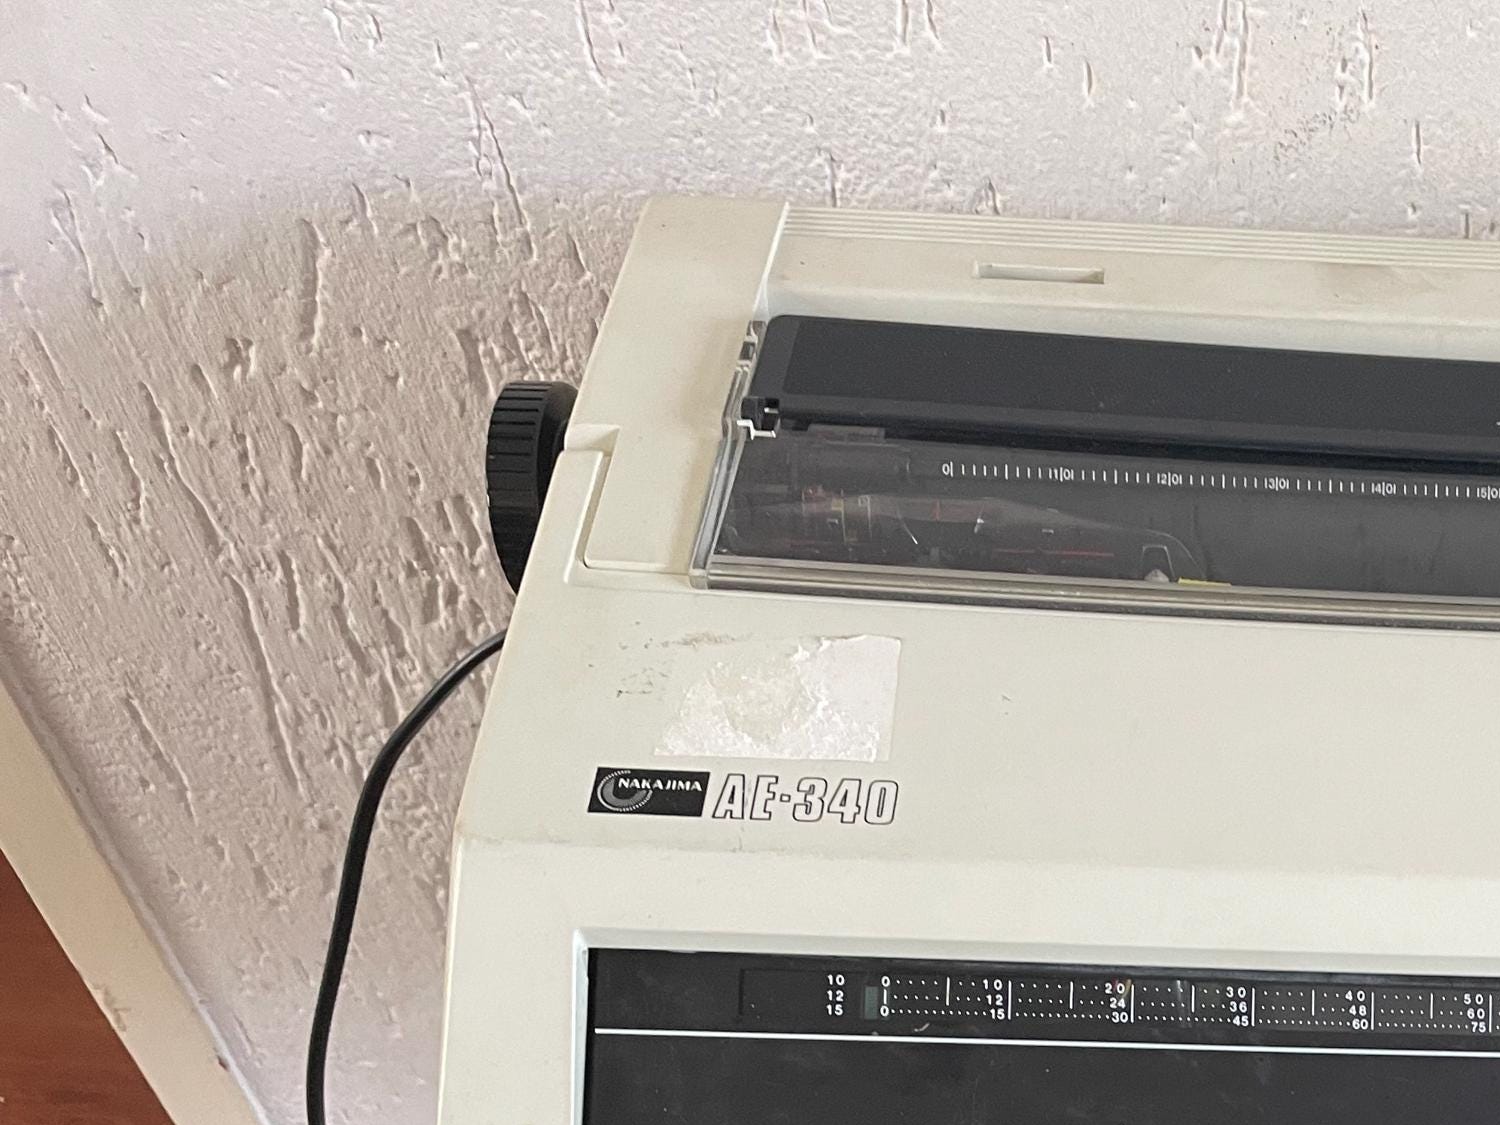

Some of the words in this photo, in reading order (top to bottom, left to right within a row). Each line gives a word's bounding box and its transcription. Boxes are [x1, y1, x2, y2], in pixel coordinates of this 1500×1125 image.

[617, 777, 702, 791] NAKAJIMA
[712, 773, 898, 825] AE-340
[827, 974, 845, 986] 10
[881, 976, 890, 987] 0
[983, 979, 1002, 990] 10
[1105, 983, 1125, 994] 20
[1226, 986, 1246, 998] 30
[1345, 990, 1365, 1001] 40
[1464, 993, 1483, 1004] 50
[826, 1005, 843, 1016] 15
[880, 1005, 889, 1017] 0
[990, 1008, 1005, 1020] 15
[1112, 1011, 1128, 1023] 30
[1233, 1015, 1249, 1026] 45
[1352, 1019, 1368, 1030] 60
[1471, 1021, 1486, 1033] 75
[827, 990, 844, 1001] 12
[987, 995, 1003, 1005] 12
[1110, 998, 1126, 1009] 24
[1230, 1001, 1247, 1013] 36
[1349, 1005, 1367, 1016] 48
[1467, 1008, 1485, 1019] 60
